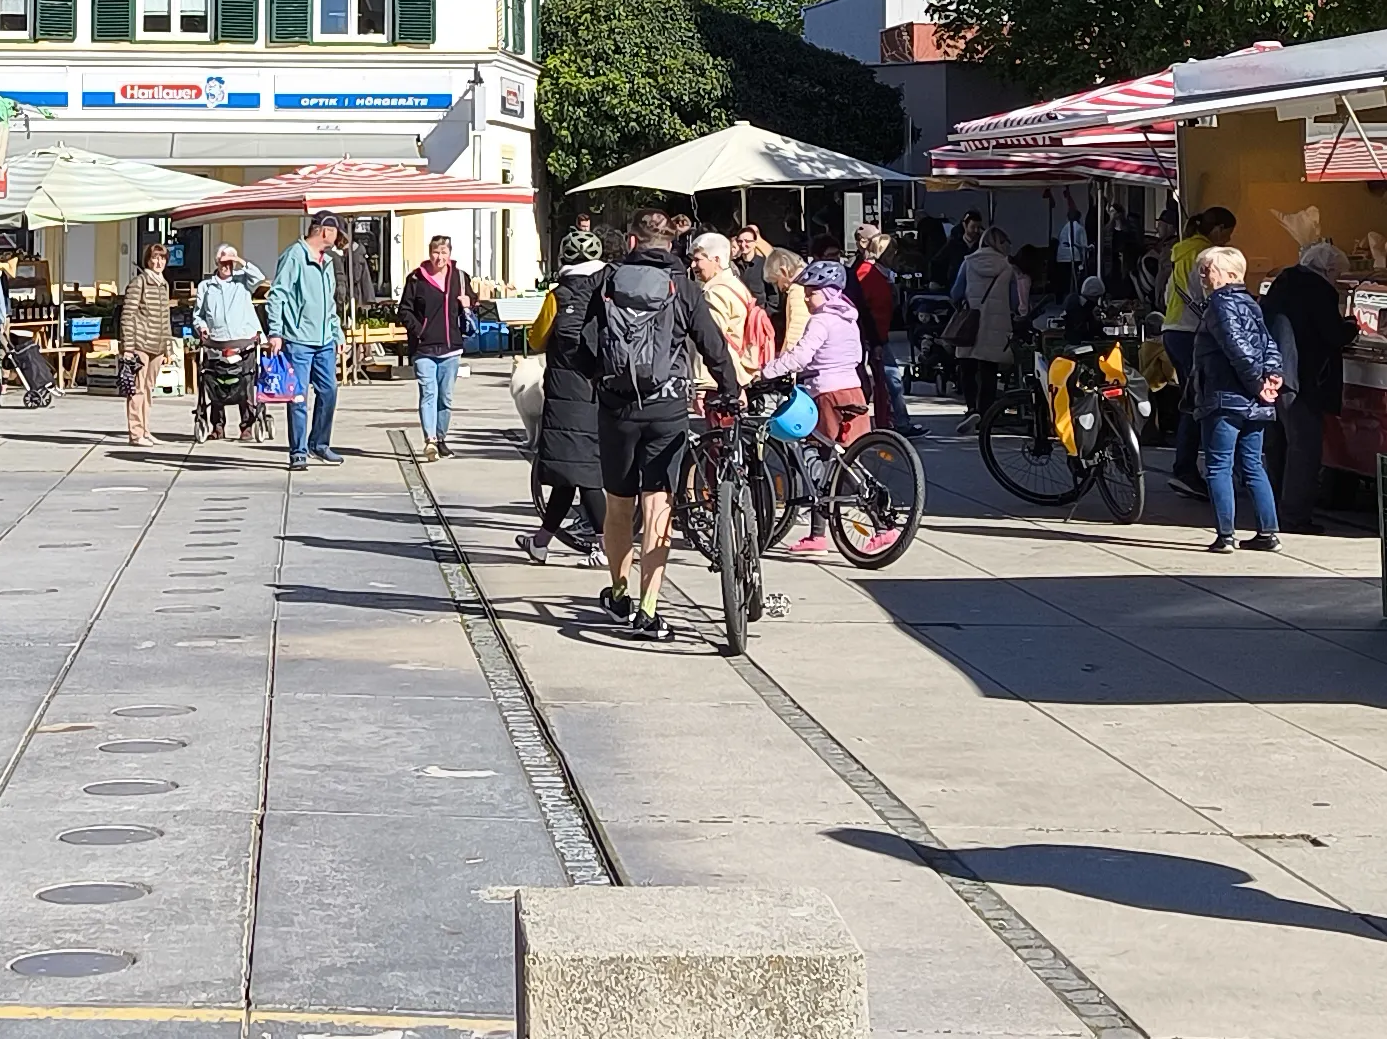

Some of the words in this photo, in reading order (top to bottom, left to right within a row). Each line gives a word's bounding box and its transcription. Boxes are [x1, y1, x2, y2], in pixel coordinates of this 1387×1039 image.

[126, 85, 198, 100] Hartlauer
[300, 97, 338, 106] OPTIK
[355, 96, 429, 107] HÖRGERÄTE
